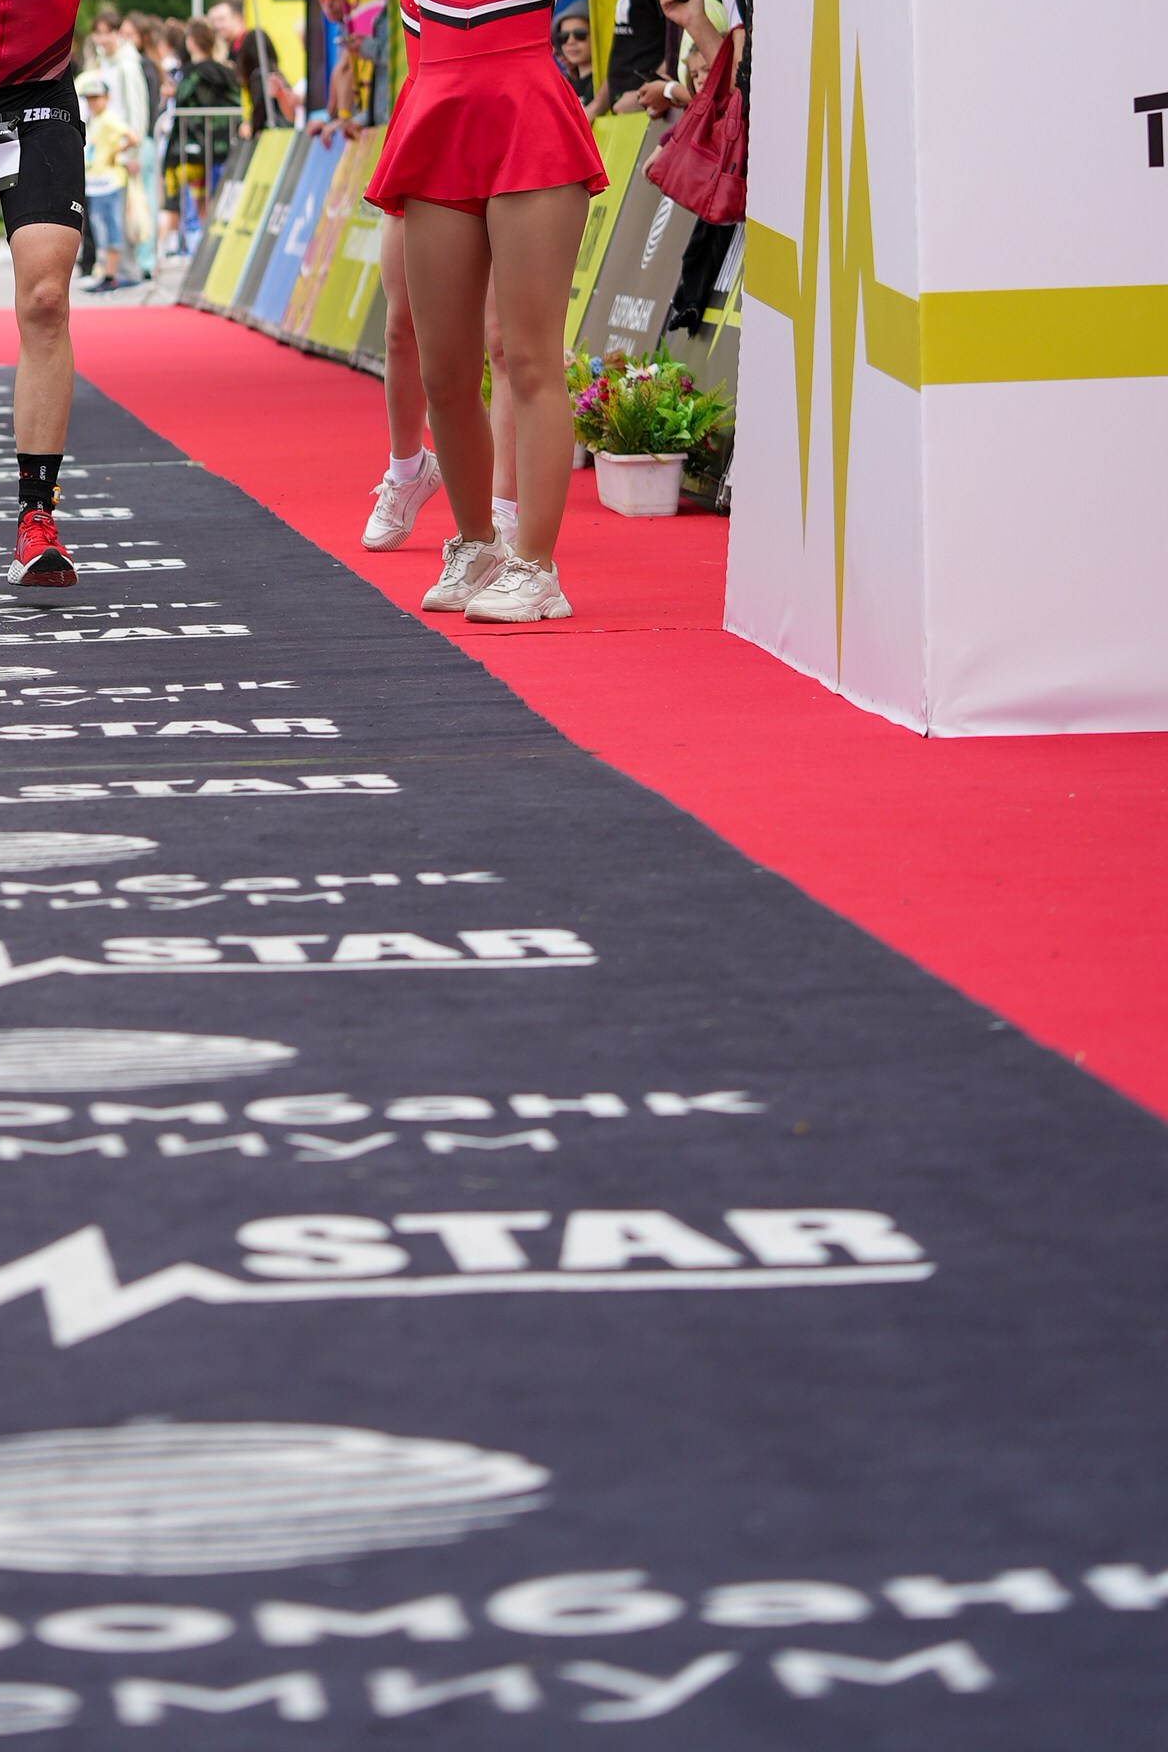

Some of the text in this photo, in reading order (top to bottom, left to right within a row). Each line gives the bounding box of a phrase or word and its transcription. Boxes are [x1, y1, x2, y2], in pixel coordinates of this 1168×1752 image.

[18, 773, 400, 799] STAR
[102, 928, 594, 964] STAR
[237, 1208, 926, 1278] STAR
